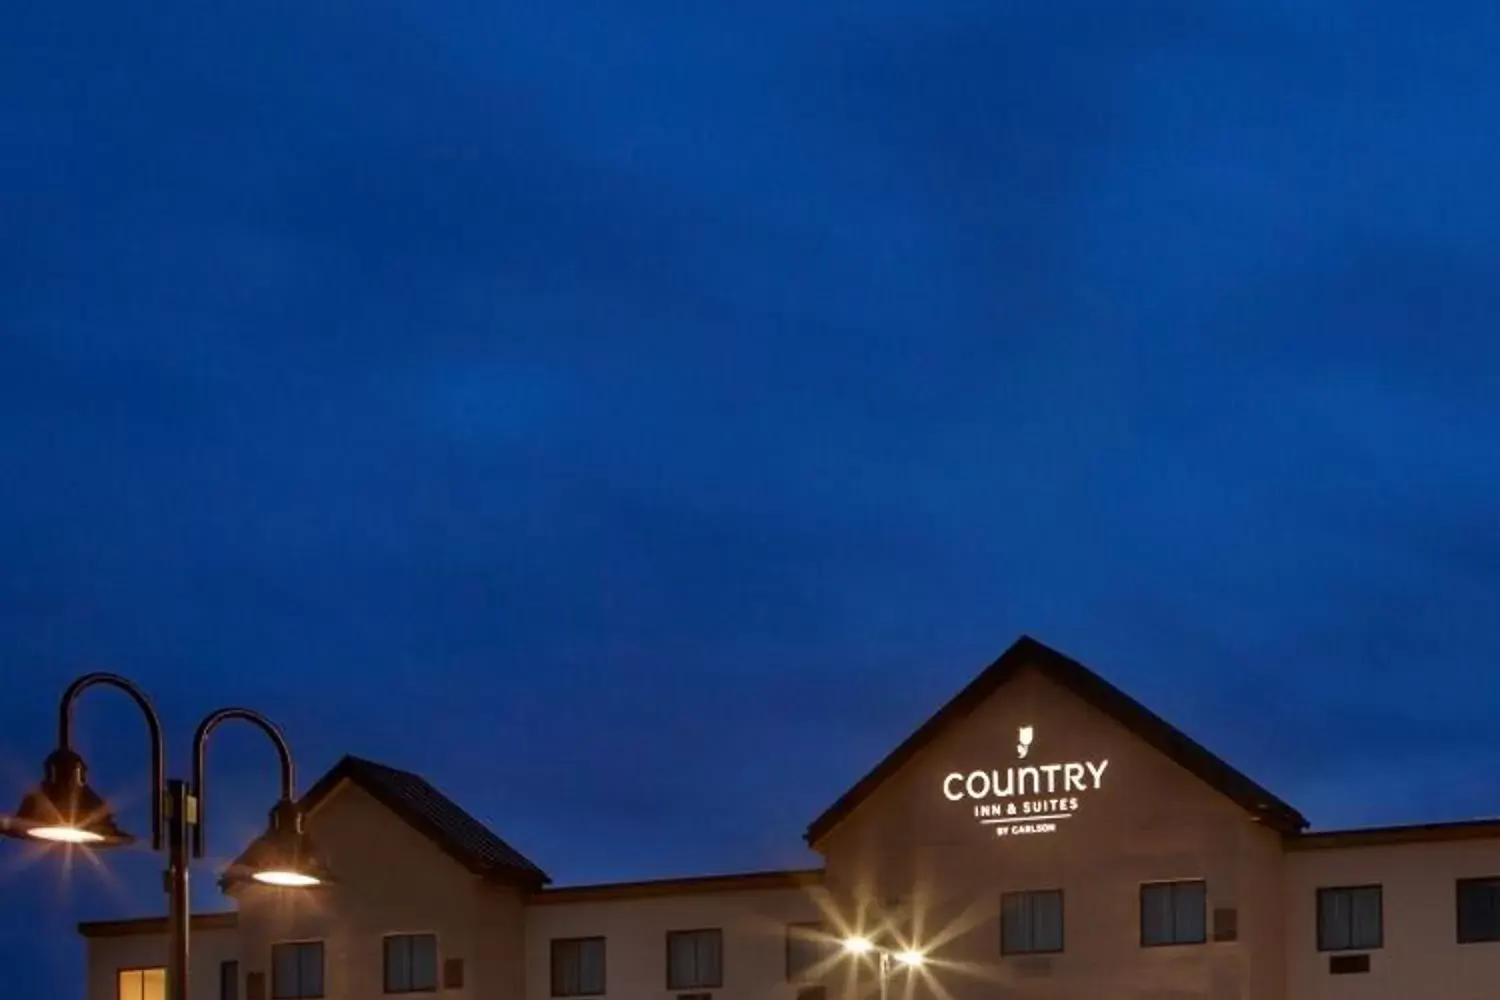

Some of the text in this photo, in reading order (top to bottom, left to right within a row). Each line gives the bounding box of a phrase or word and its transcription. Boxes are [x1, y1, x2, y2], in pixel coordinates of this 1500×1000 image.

[974, 797, 1079, 817] INN & SUITES
[996, 823, 1057, 836] BY CARLSON
